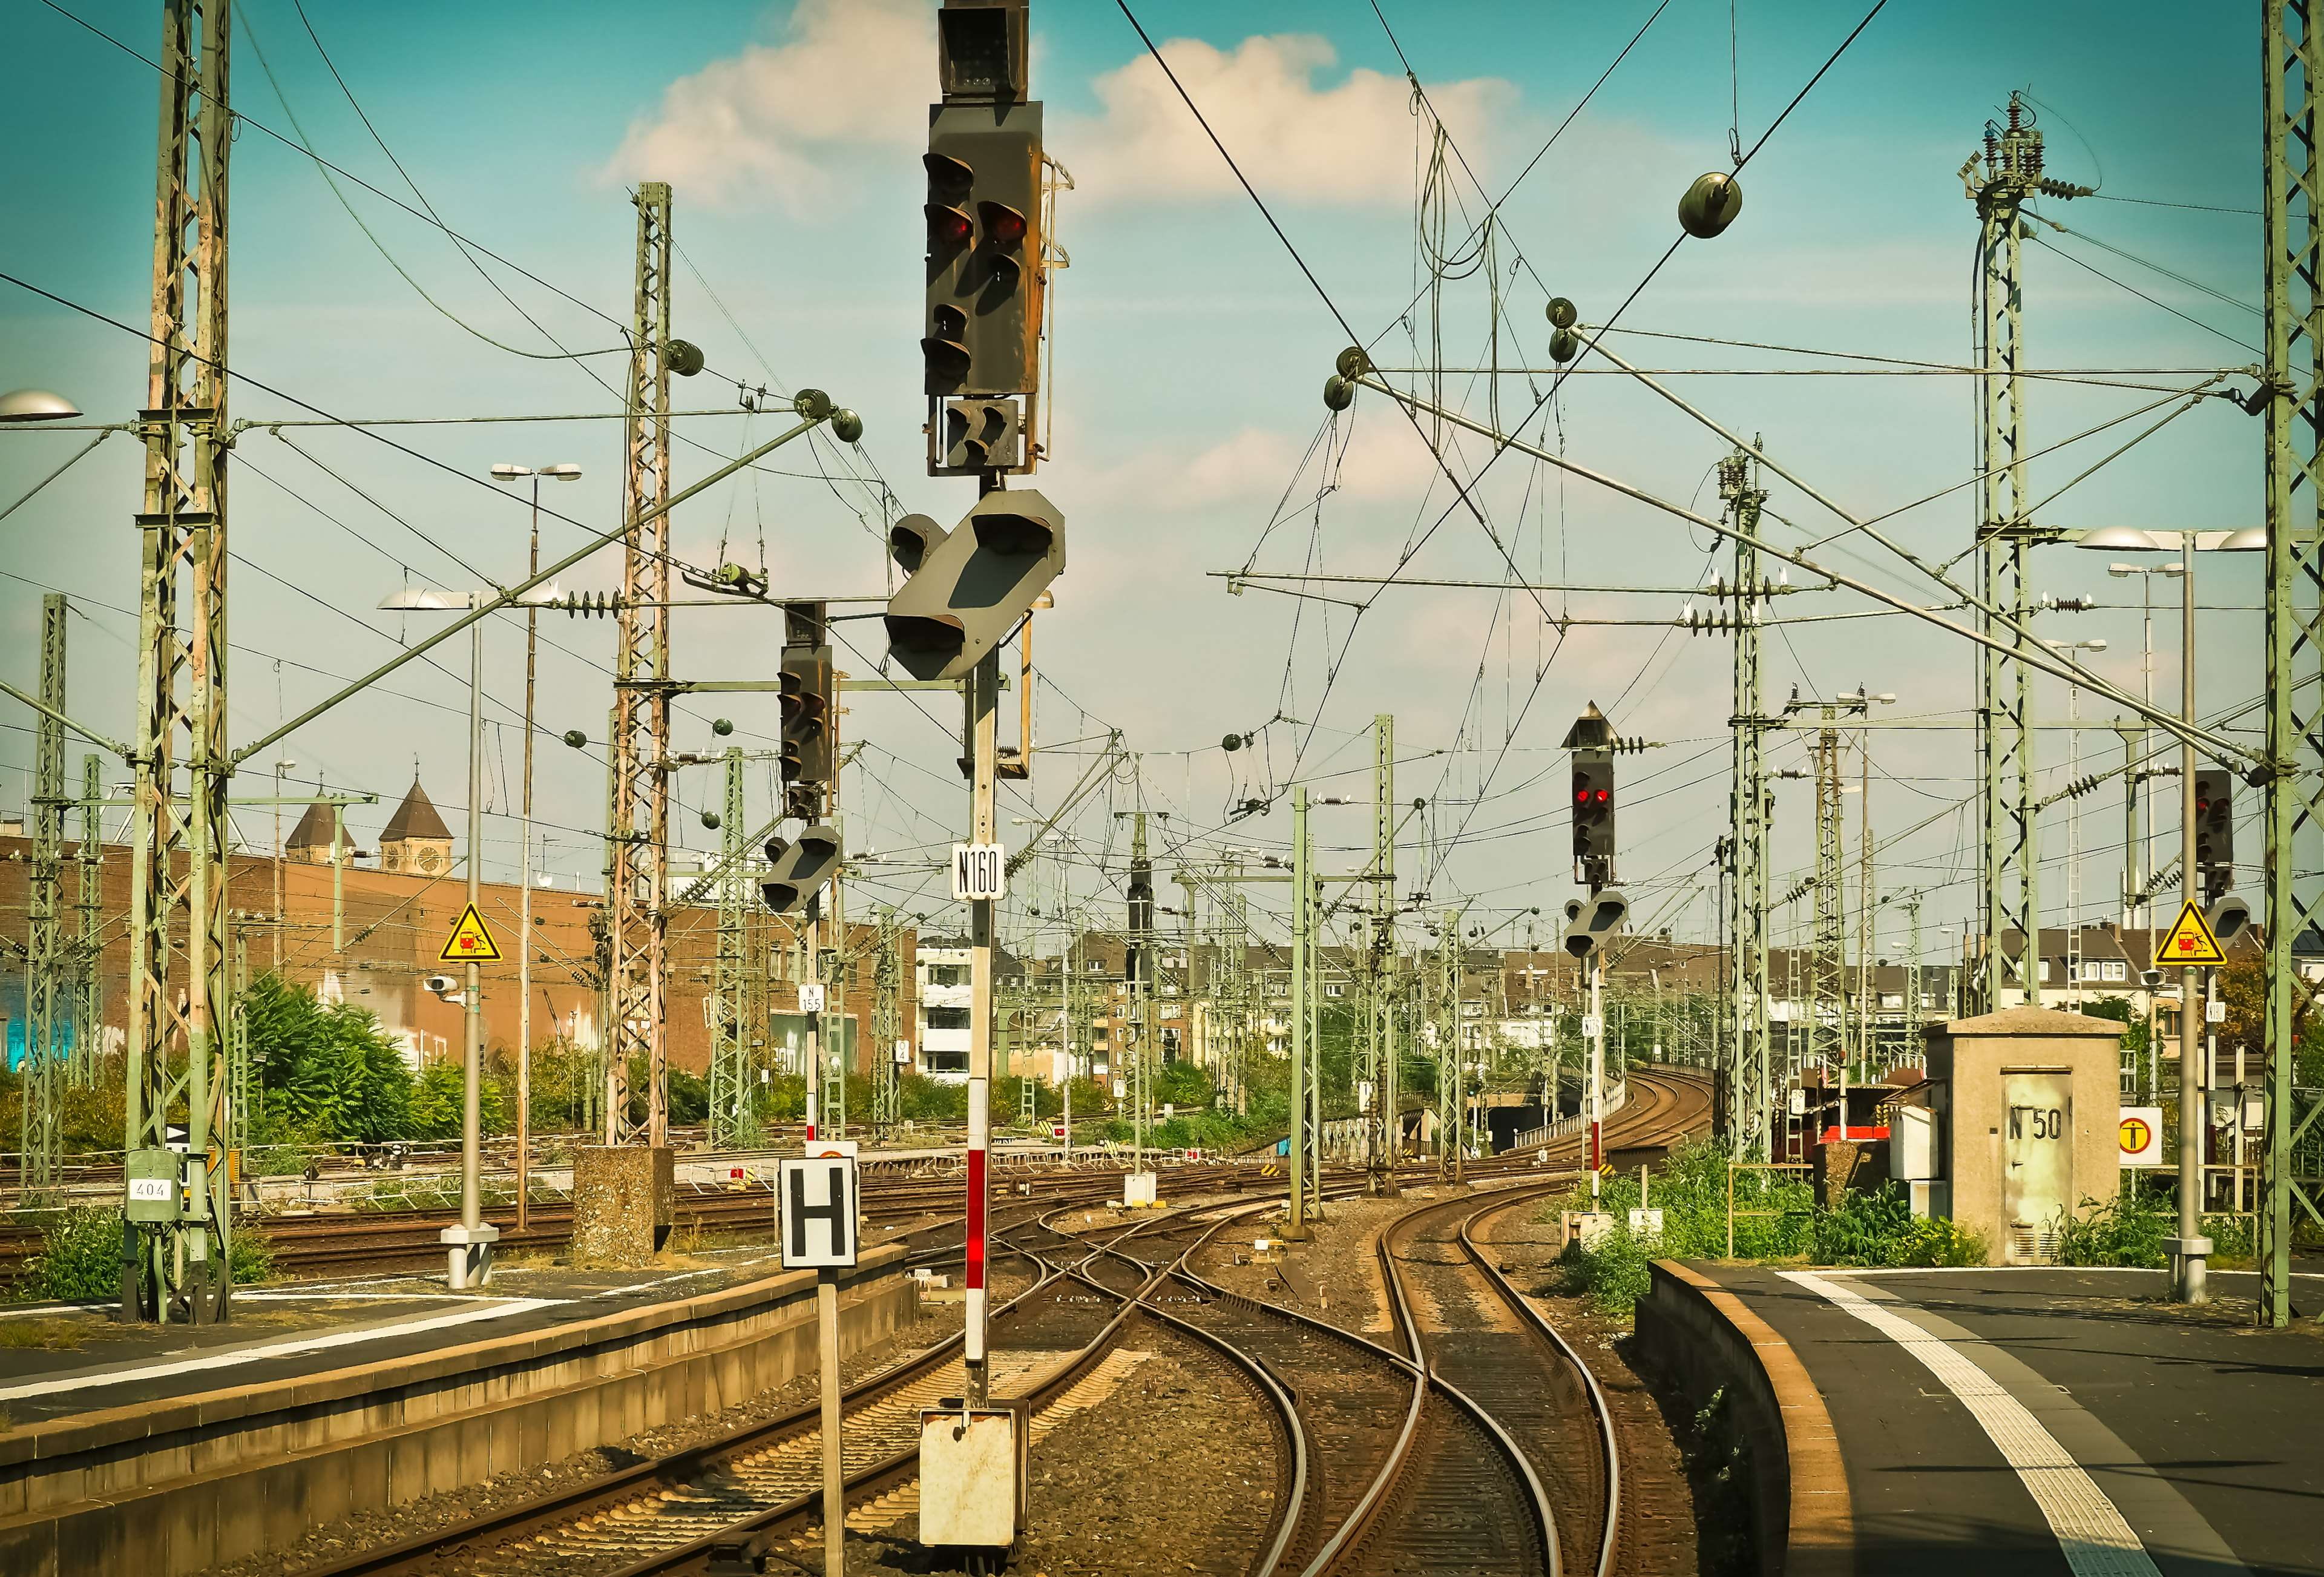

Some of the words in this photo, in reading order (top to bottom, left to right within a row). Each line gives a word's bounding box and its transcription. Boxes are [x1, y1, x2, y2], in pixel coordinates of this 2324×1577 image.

[959, 851, 997, 893] N160
[809, 987, 814, 997] N
[803, 998, 821, 1010] 155
[899, 1051, 905, 1059] 4
[2009, 1107, 2022, 1139] N
[2033, 1108, 2061, 1139] 50
[136, 1184, 163, 1196] 404
[790, 1167, 845, 1257] H
